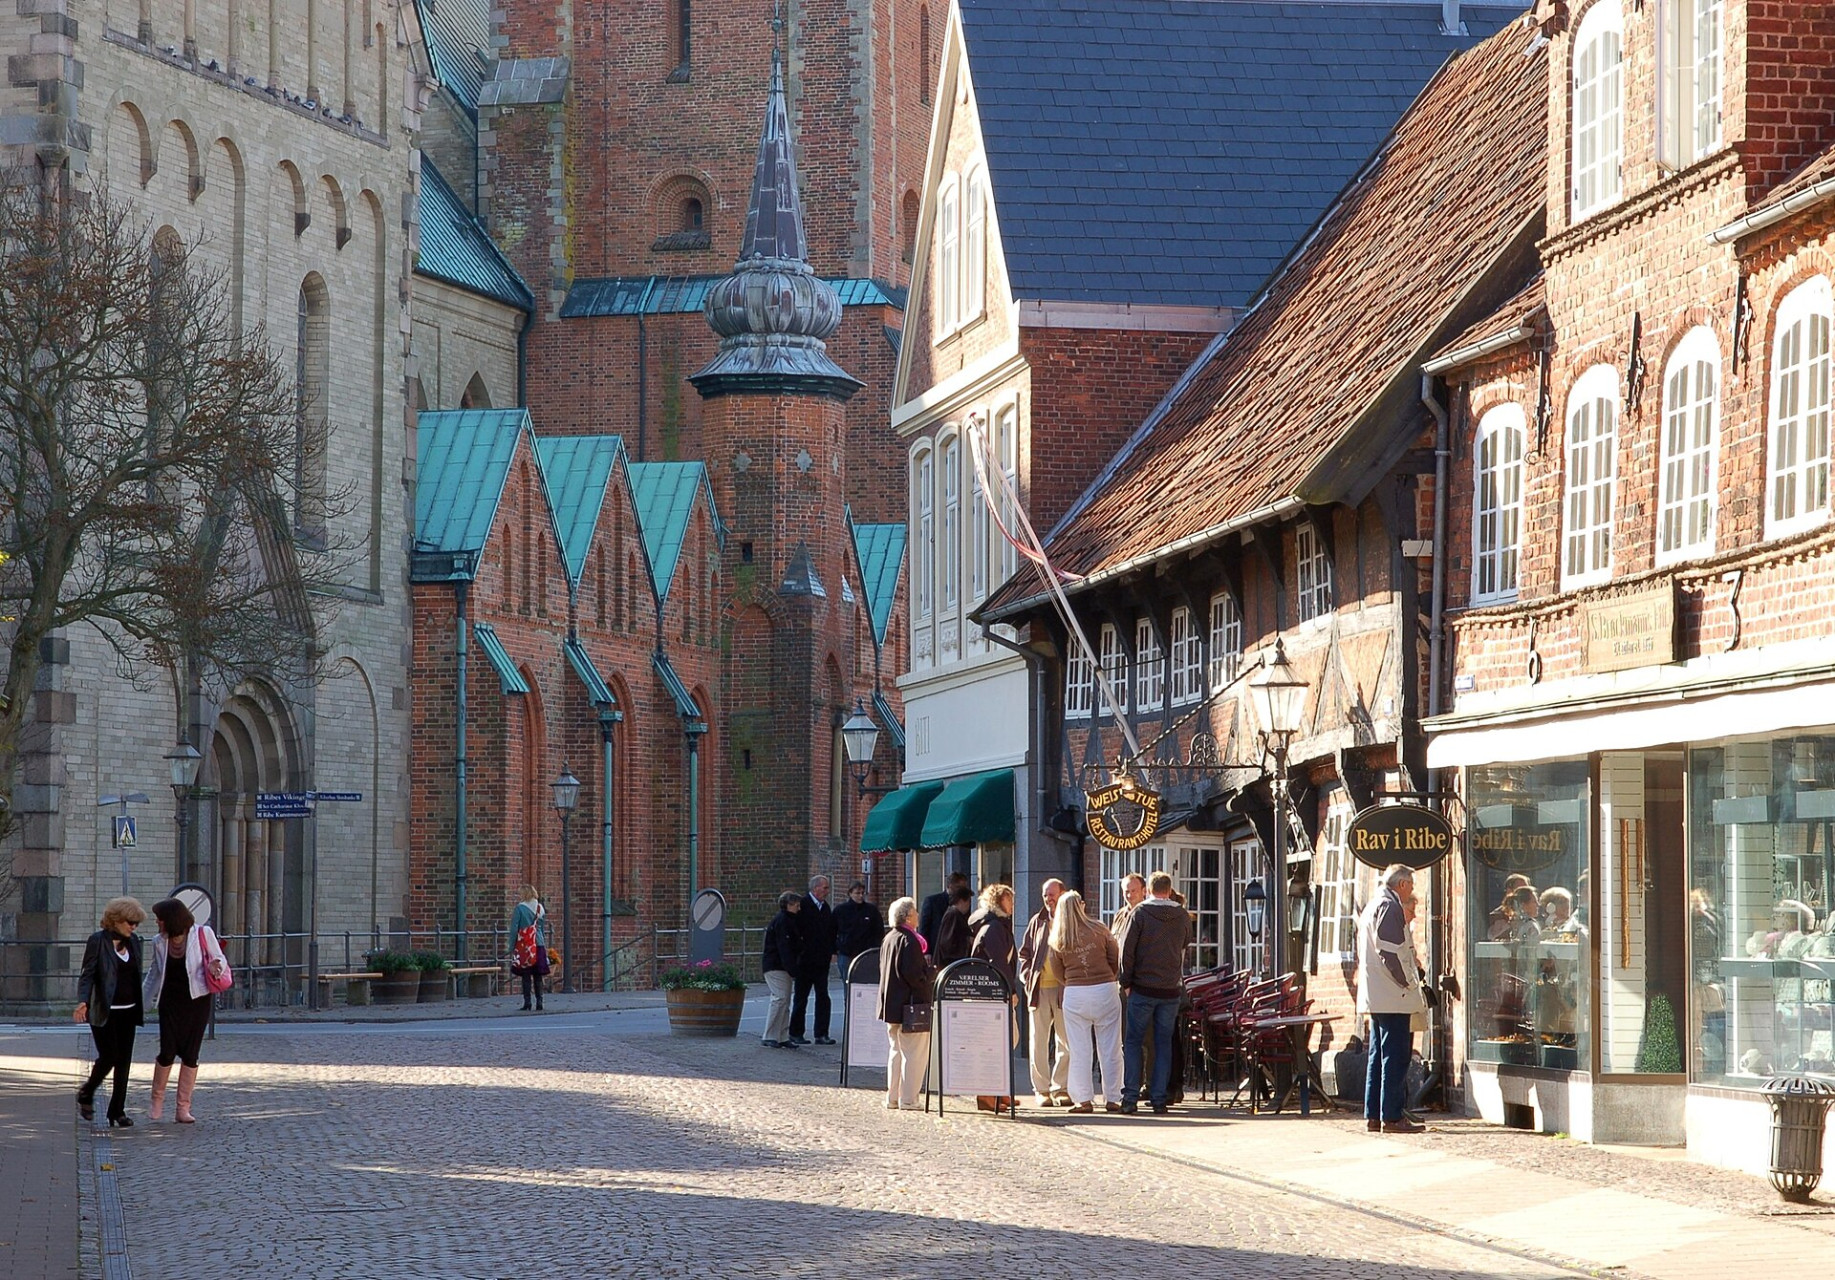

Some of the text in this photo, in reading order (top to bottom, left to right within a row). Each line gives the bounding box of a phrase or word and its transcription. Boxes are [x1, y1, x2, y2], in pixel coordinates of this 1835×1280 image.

[1090, 789, 1119, 809] WEIS
[1356, 826, 1447, 850] Rav i Ribe
